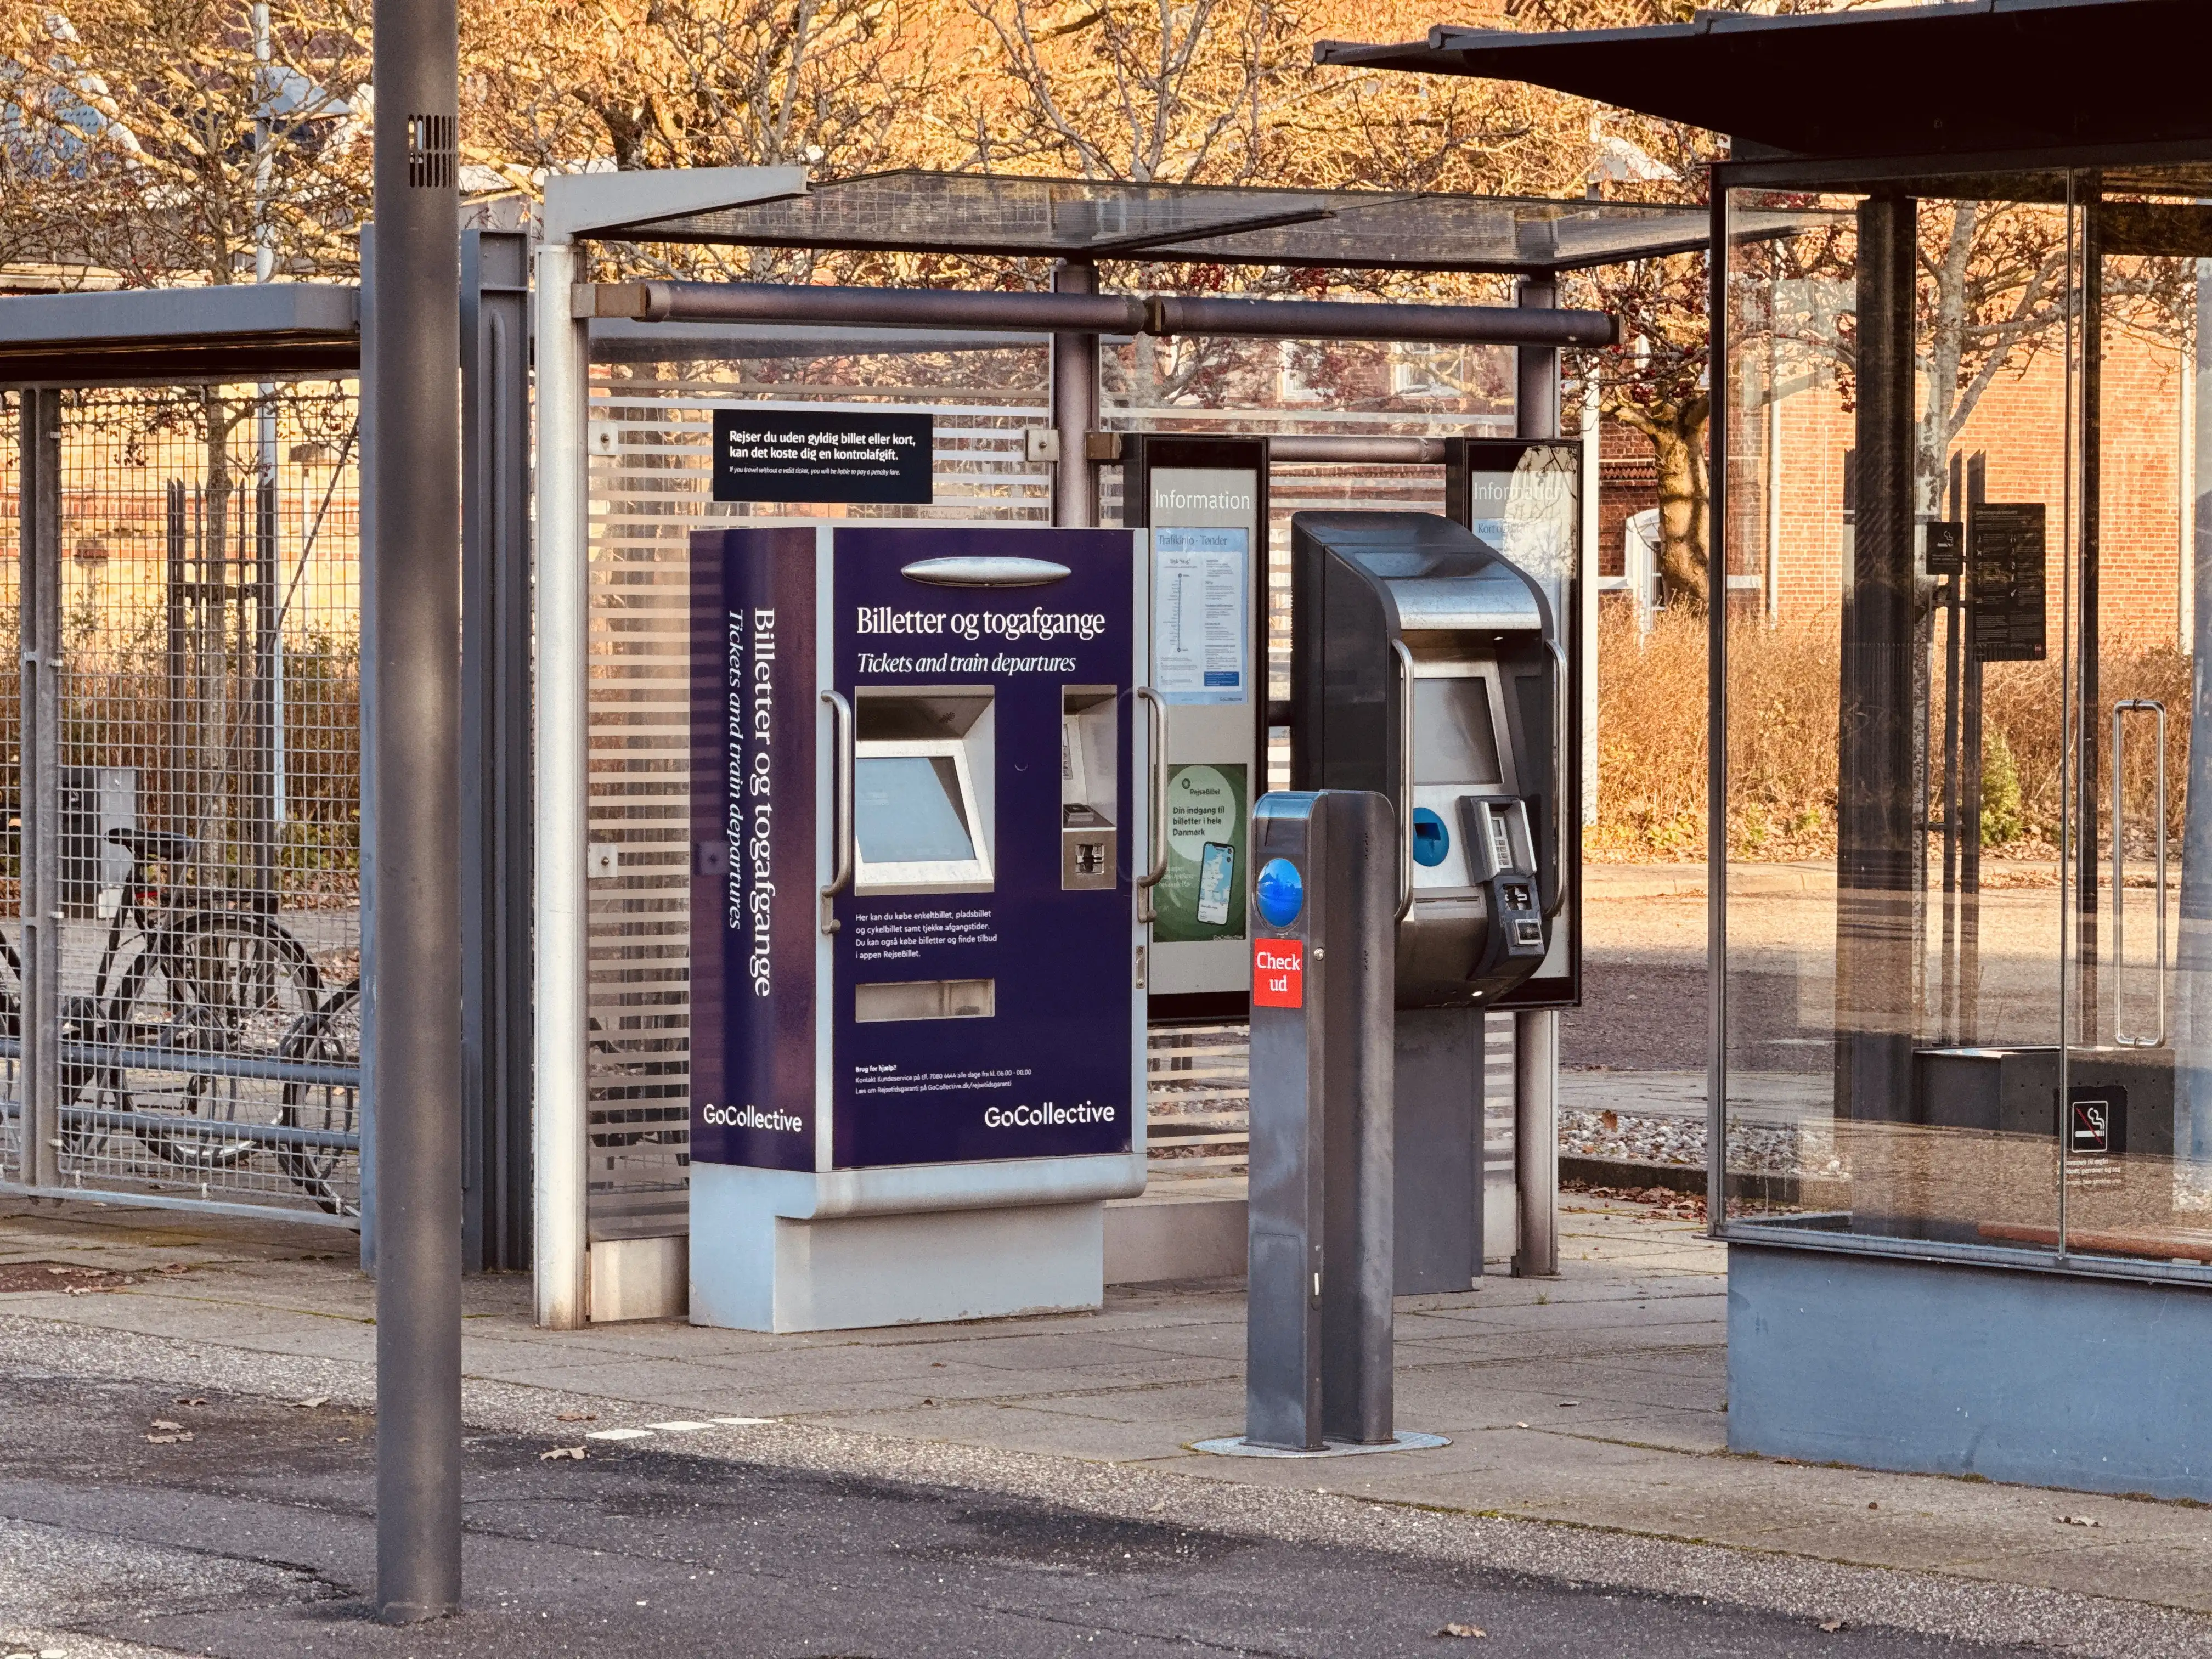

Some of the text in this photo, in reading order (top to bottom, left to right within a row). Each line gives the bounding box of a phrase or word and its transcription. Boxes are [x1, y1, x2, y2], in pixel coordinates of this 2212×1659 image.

[730, 431, 916, 447] Rejser du uden gyldig billet eller kort,
[730, 446, 898, 462] kan det koste dig en kontrolafgift.
[1155, 490, 1250, 510] Information
[1478, 523, 1496, 533] Kort
[1158, 534, 1194, 545] Trafikinfo
[1200, 535, 1227, 545] Tønder
[856, 607, 1105, 641] Billetter og togafgange
[857, 652, 1076, 676] Tickets and train departures
[727, 610, 743, 930] Tickets and train departures
[749, 608, 775, 997] Billetter og togafgange
[1187, 806, 1216, 815] indgang
[895, 912, 912, 920] købe
[914, 911, 954, 920] enkeltbillet,
[956, 910, 991, 919] pladsbillet
[867, 925, 902, 935] cykelbillet
[923, 924, 944, 933] tjekke
[945, 922, 990, 932] afgangstider.
[881, 937, 898, 947] også
[919, 936, 945, 944] billetter
[977, 934, 997, 943] tilbud
[884, 950, 921, 960] RejseBillet.
[1257, 952, 1301, 970] Check
[1269, 975, 1288, 992] ud
[878, 1085, 919, 1093] Rejsetidsgaranti
[928, 1080, 1012, 1090] GoCollective.dk/rejsetidsgaranti
[703, 1104, 802, 1132] GoCollective
[984, 1100, 1115, 1127] GoCollective
